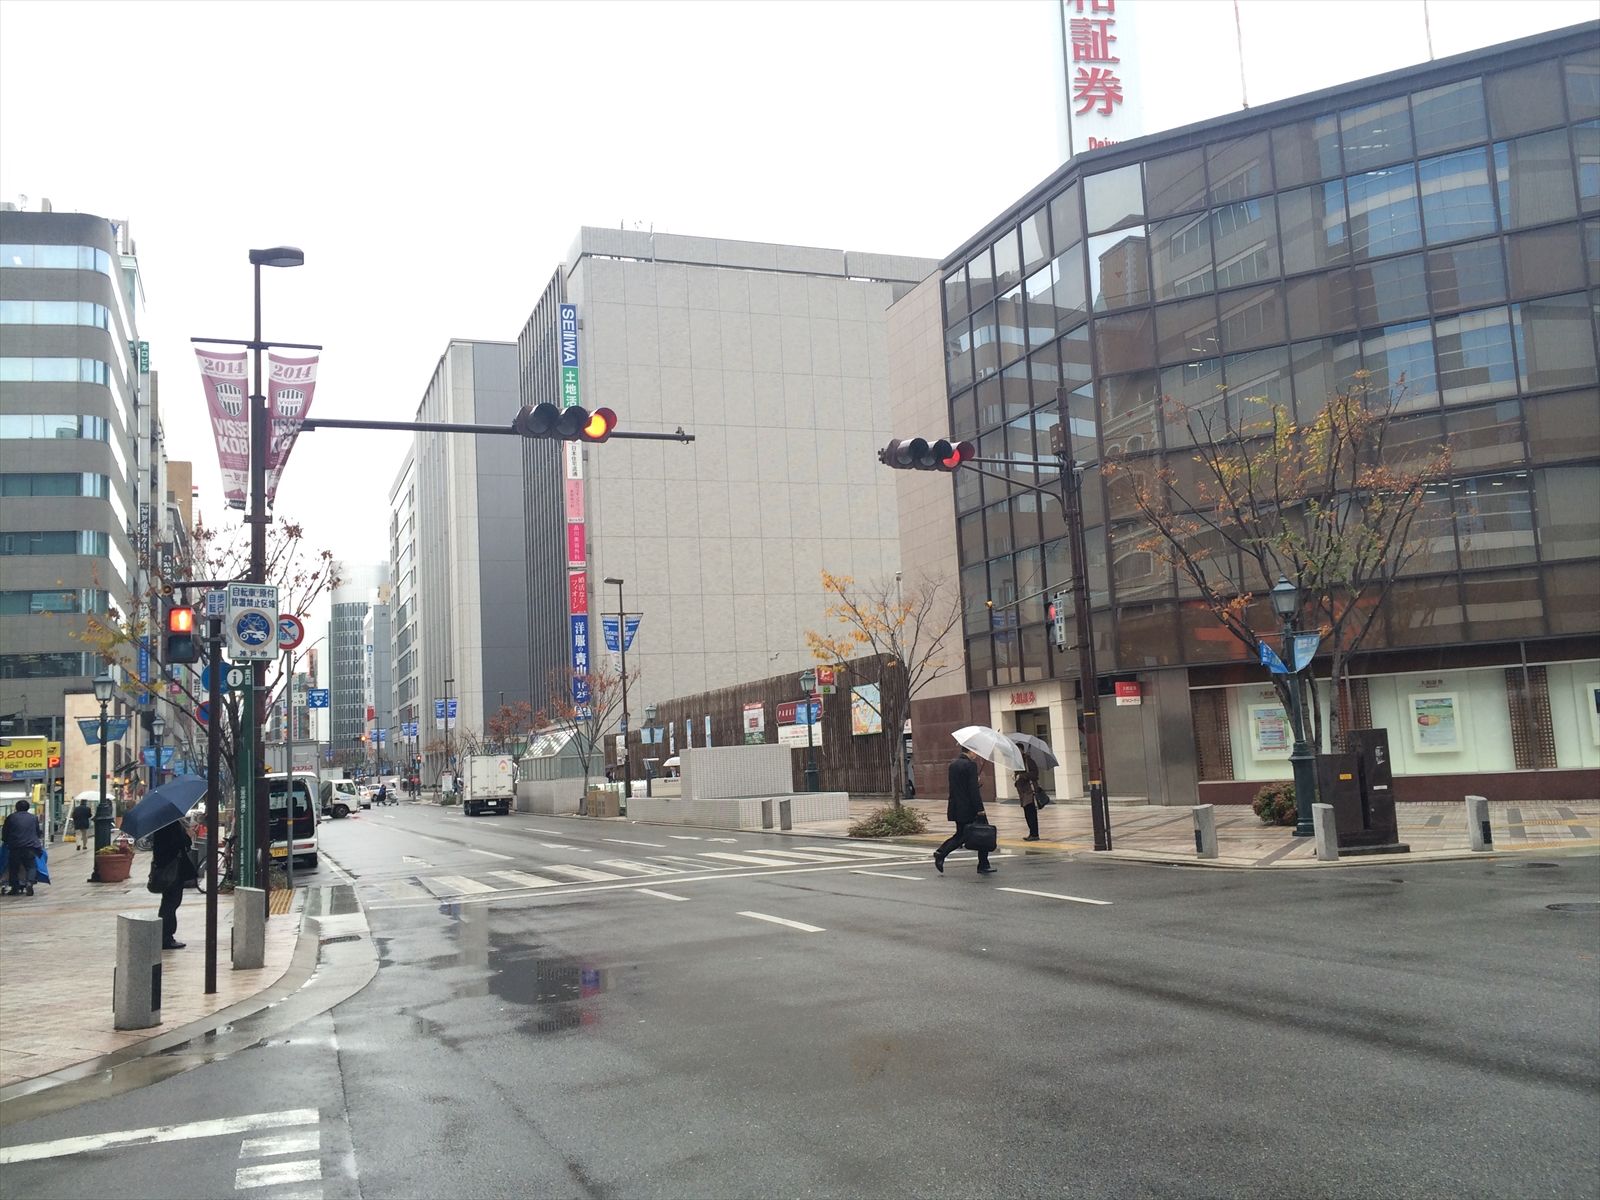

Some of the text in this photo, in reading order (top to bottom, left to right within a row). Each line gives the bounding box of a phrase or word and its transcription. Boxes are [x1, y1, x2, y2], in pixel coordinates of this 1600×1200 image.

[204, 359, 244, 374] 2014
[273, 365, 313, 379] 2014
[575, 621, 587, 676] 洋服の青山
[49, 758, 60, 768] P
